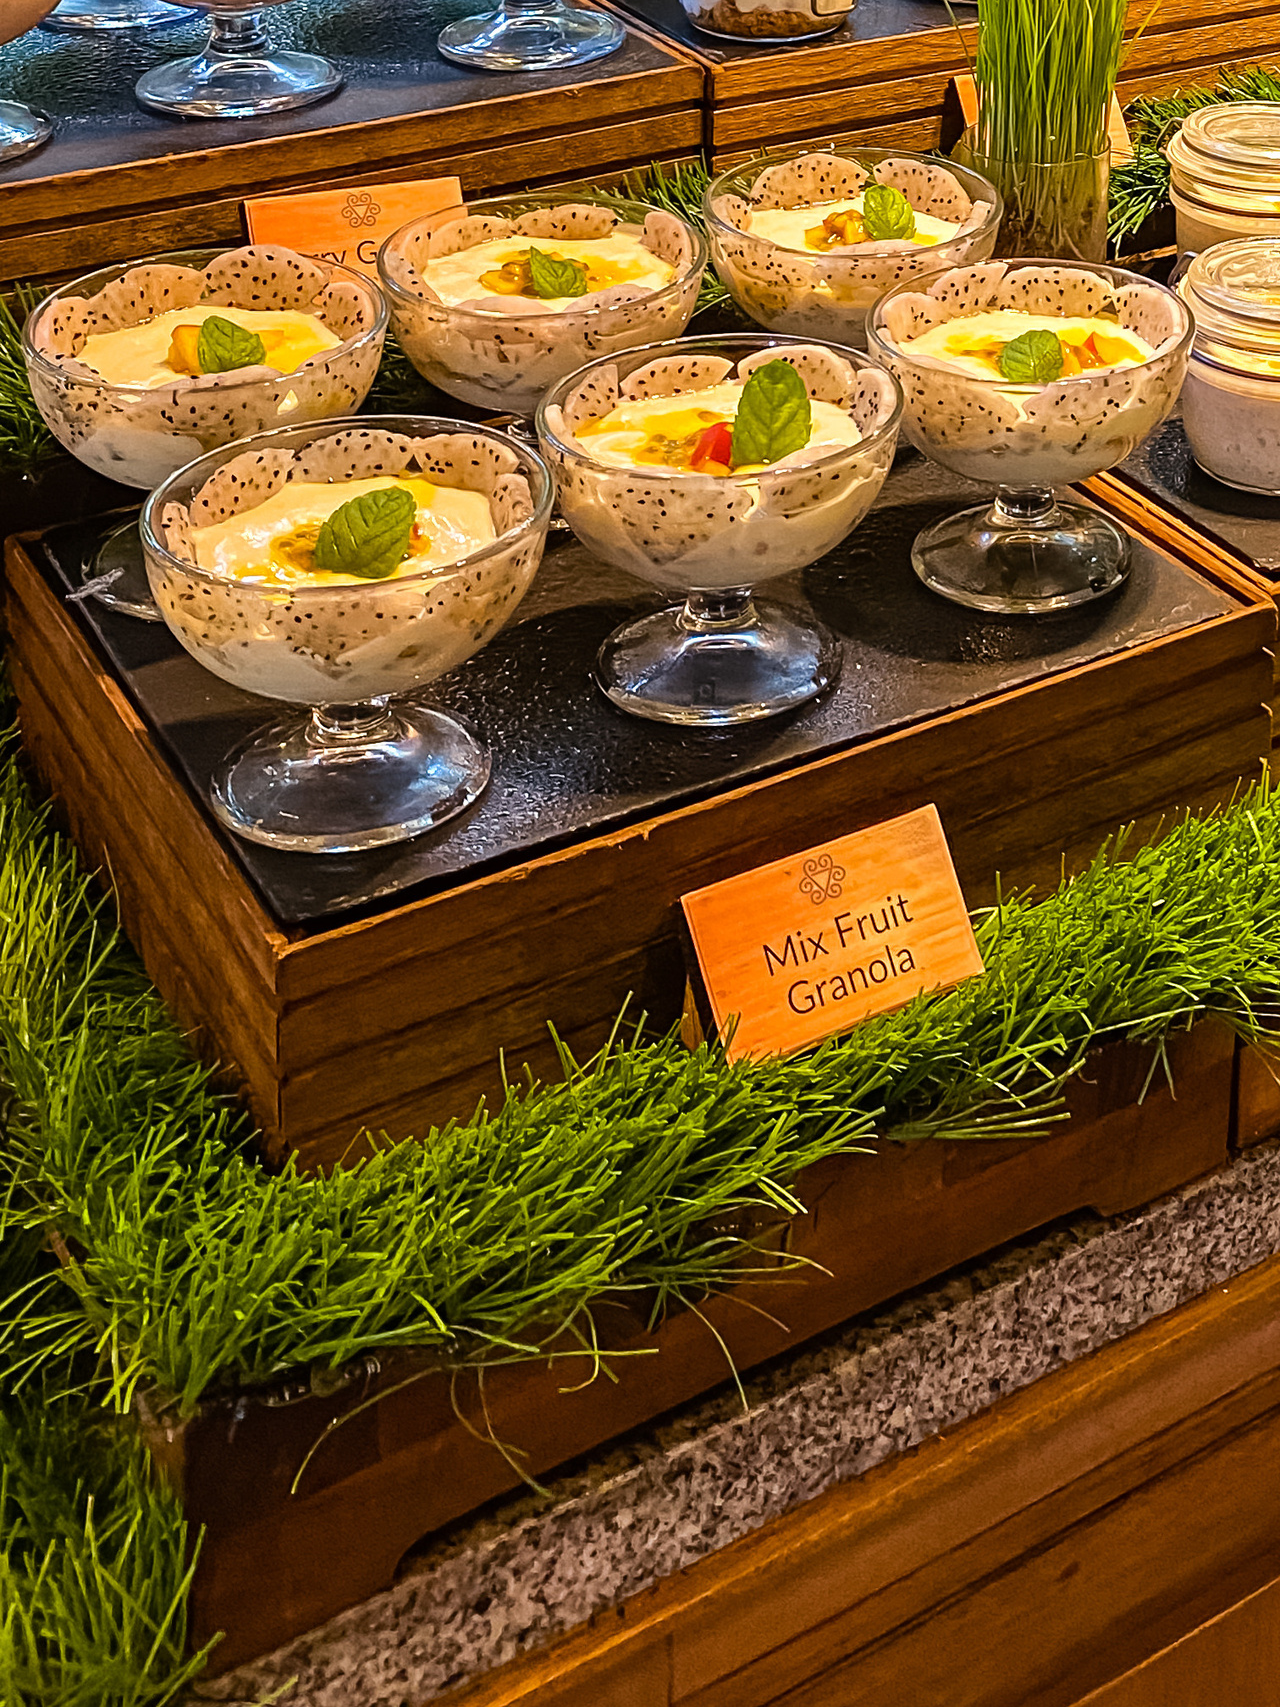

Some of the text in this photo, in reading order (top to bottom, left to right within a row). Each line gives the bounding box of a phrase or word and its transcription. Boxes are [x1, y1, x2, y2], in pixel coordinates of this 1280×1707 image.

[762, 894, 914, 976] Mix Fruit
[787, 945, 916, 1014] Granola
